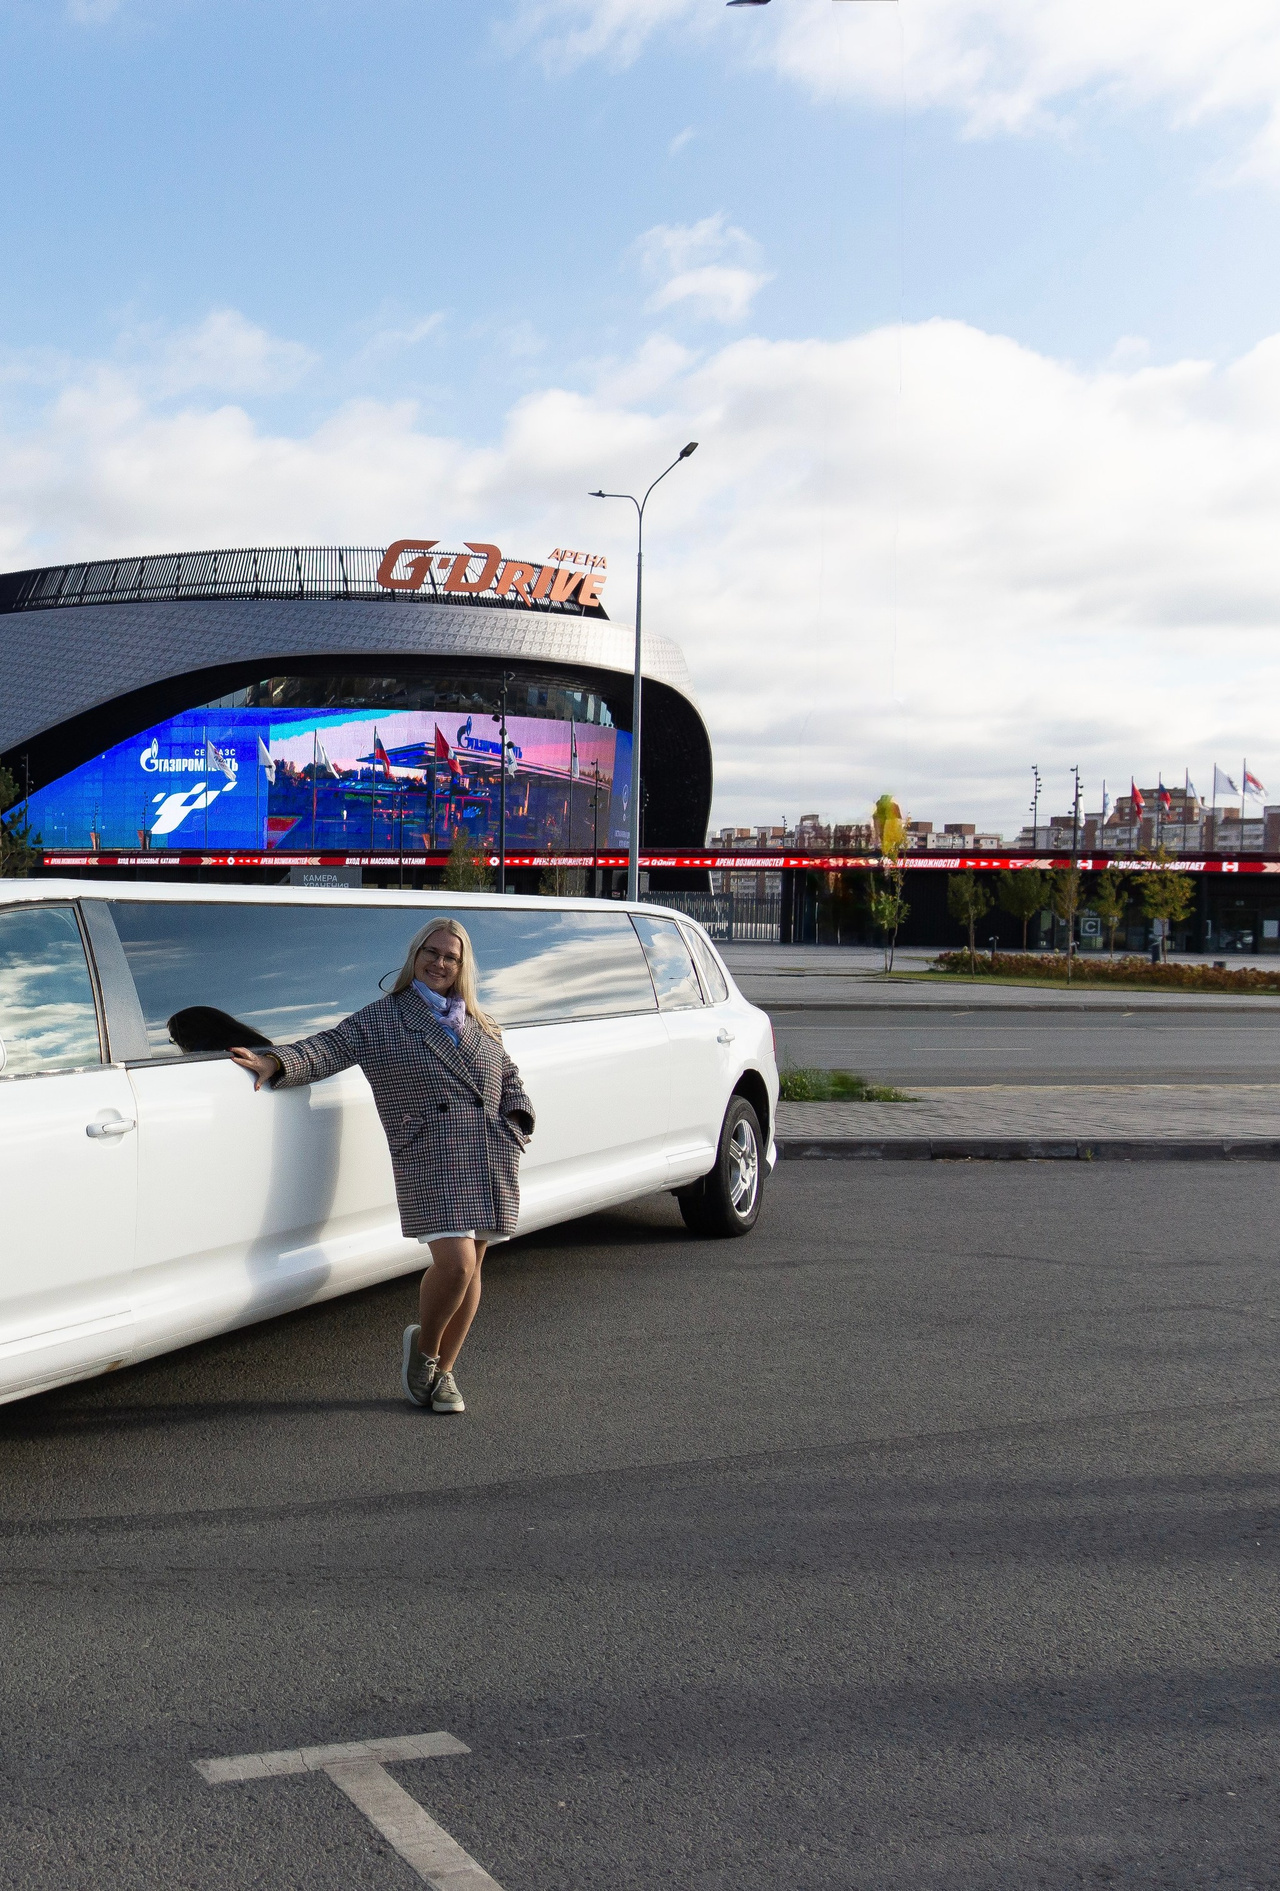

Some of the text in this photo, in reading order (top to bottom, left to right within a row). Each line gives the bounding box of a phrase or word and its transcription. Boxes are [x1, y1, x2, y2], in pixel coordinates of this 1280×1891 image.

[548, 548, 608, 569] АРЕНА
[345, 857, 360, 865] ВХОД
[361, 857, 369, 865] НА
[370, 857, 400, 865] МАССОВЫЕ
[715, 857, 784, 866] АРЕНА ВОЗМОЖНОСТЕЙ
[303, 874, 338, 882] КАМЕРА
